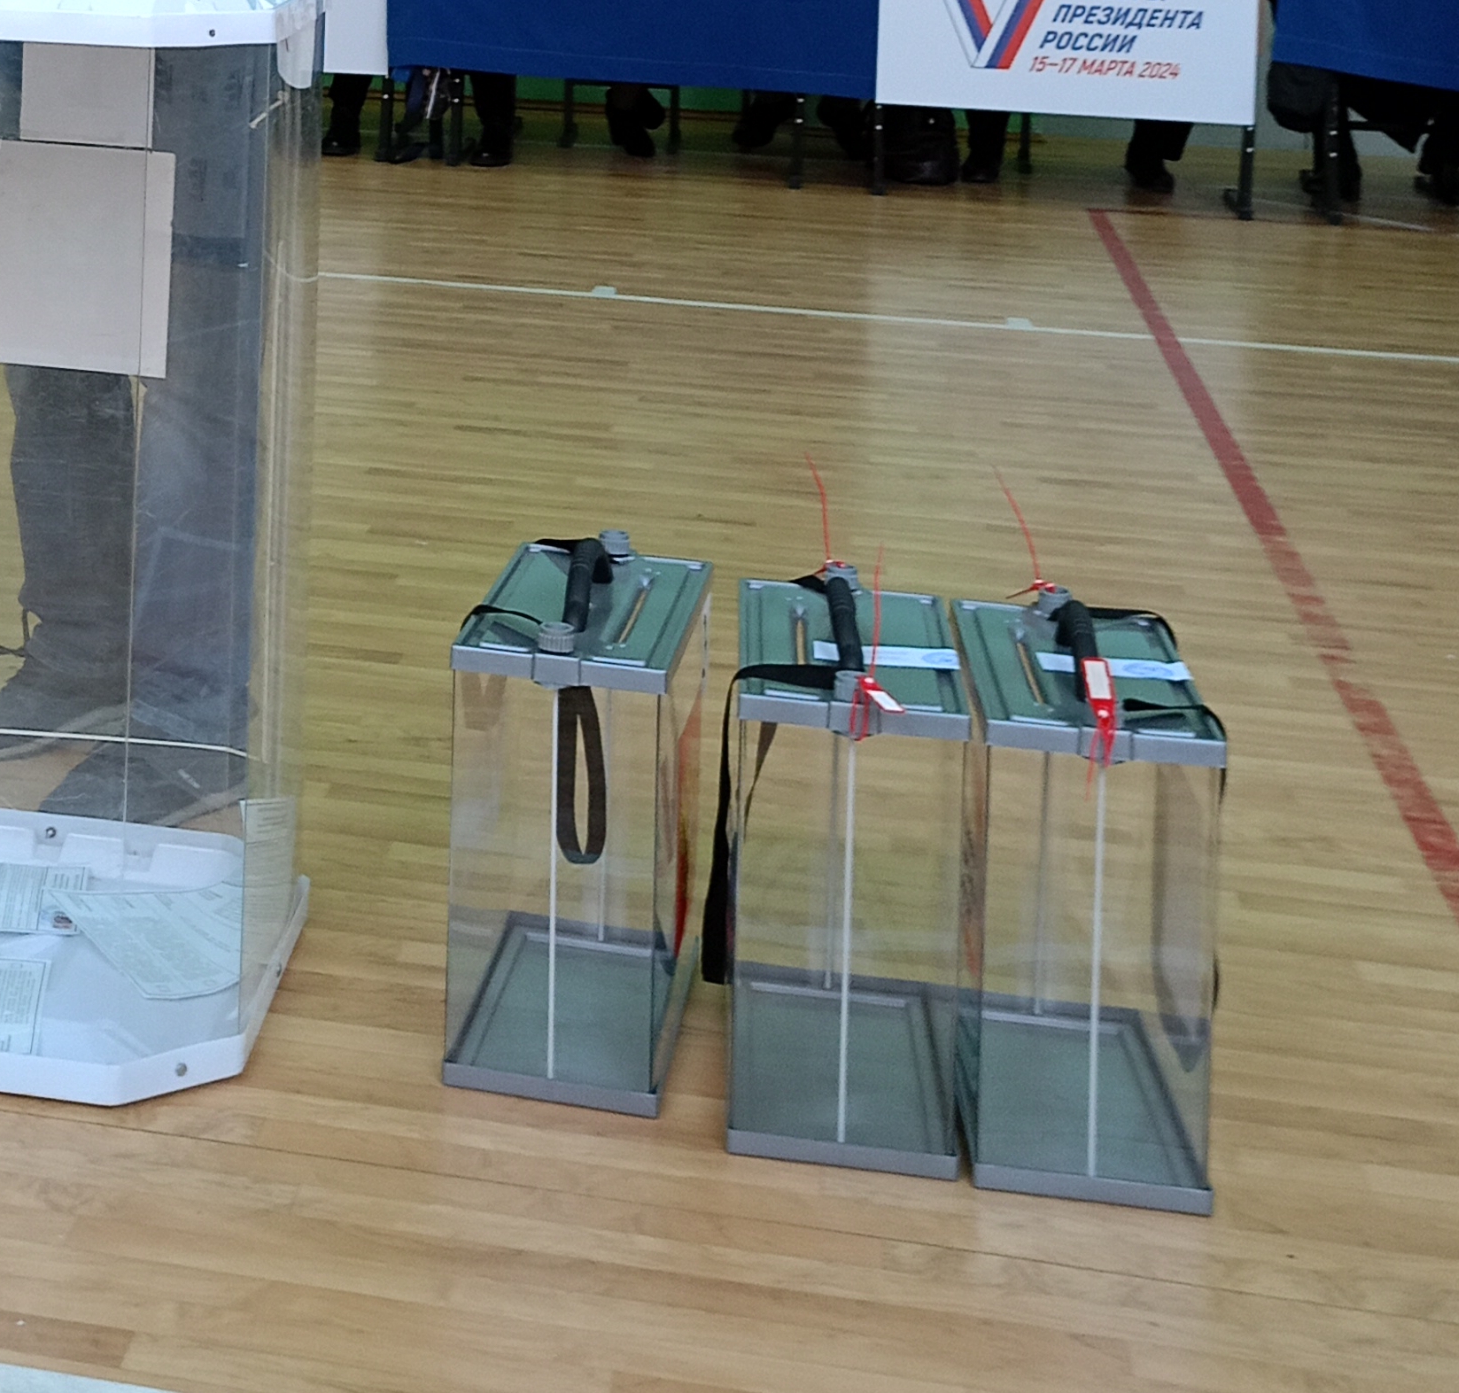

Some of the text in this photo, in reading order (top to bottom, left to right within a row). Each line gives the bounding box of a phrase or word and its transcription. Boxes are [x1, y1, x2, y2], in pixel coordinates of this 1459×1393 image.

[1052, 4, 1204, 30] ПРЕЗИДЕНТА
[1039, 31, 1137, 54] РОССИИ
[1079, 58, 1135, 78] МАРТА
[1138, 61, 1181, 80] 2024
